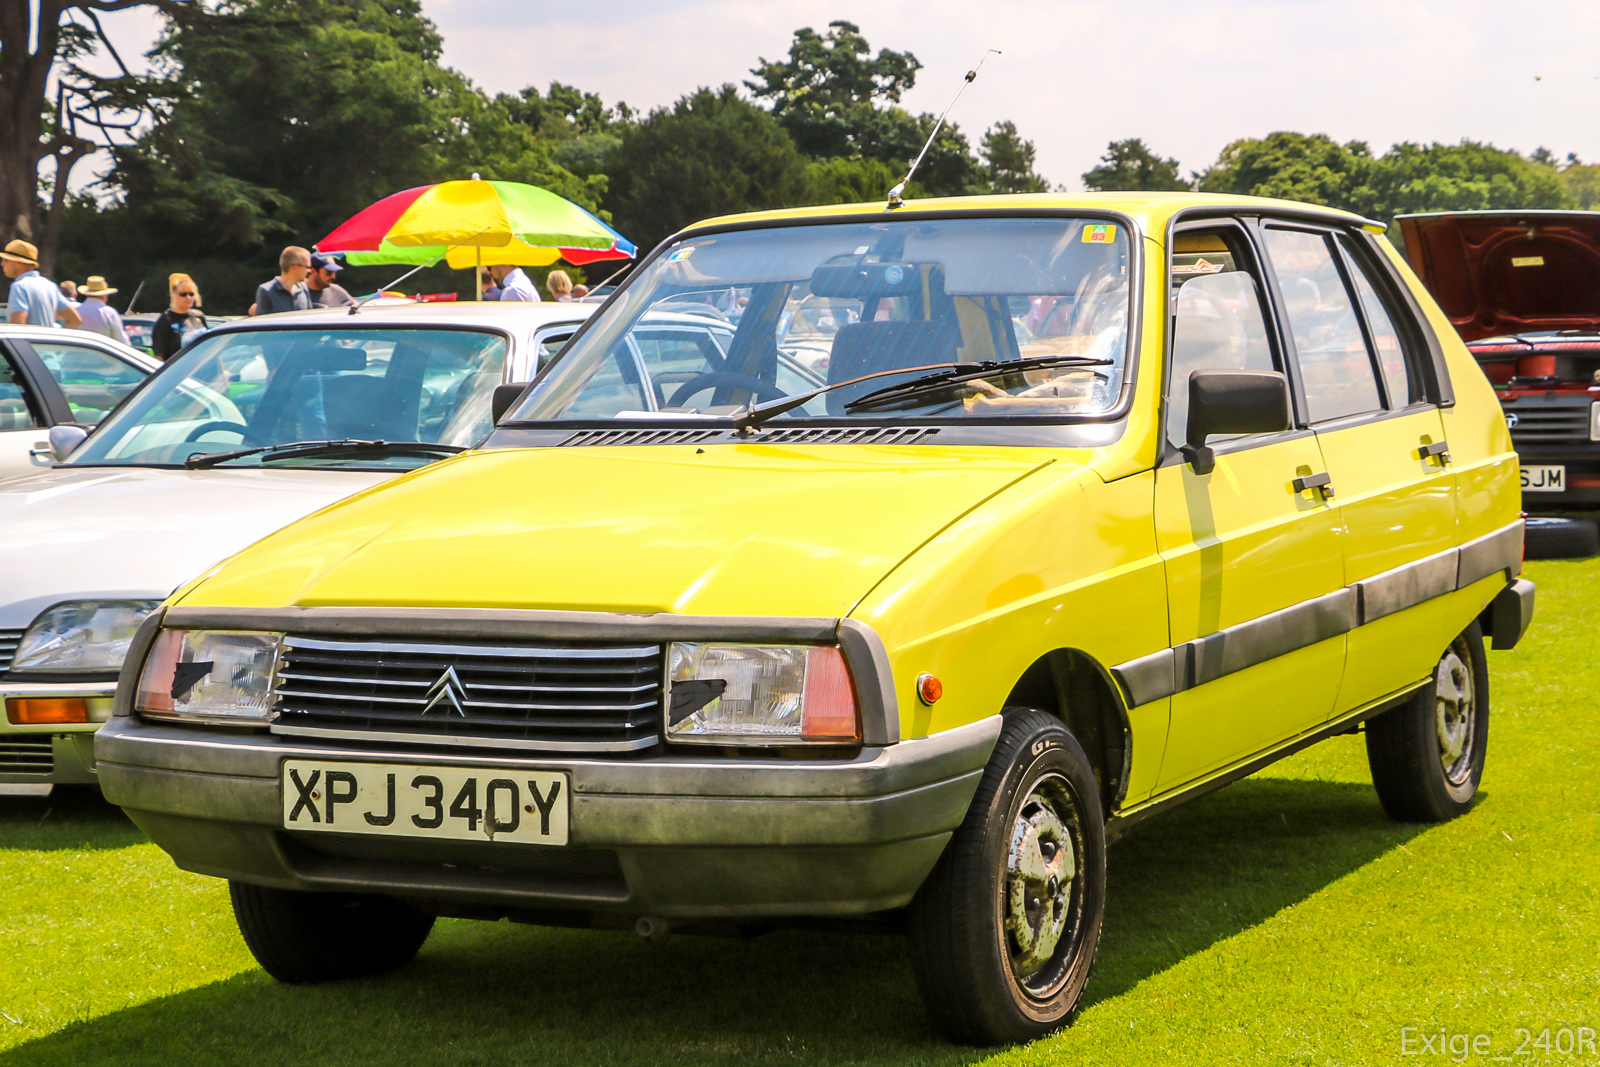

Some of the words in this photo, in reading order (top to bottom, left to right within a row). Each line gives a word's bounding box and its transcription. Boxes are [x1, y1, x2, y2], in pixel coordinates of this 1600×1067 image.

[1520, 469, 1562, 488] SJM
[289, 768, 397, 826] XPJ
[411, 775, 561, 836] 340Y
